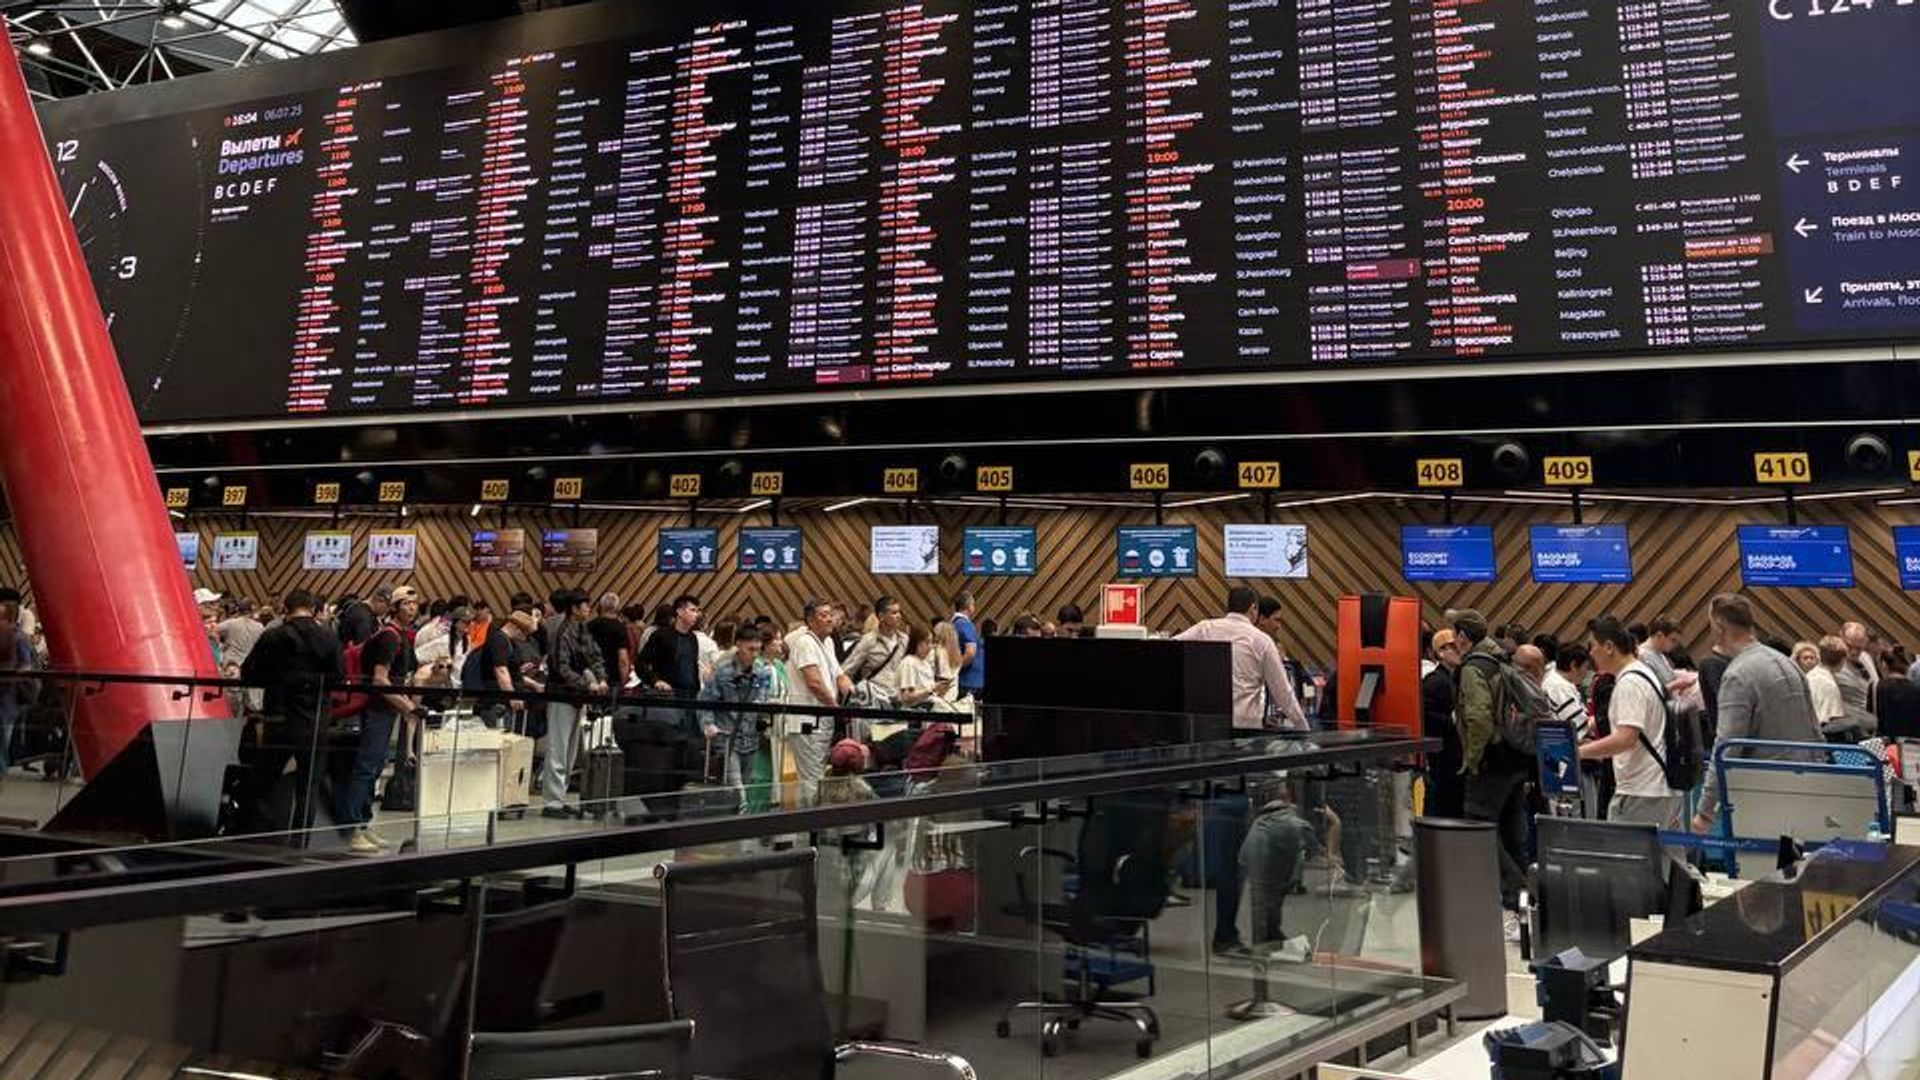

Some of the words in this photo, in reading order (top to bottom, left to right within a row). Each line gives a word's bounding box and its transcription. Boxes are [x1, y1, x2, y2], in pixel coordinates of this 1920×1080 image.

[56, 140, 80, 162] 12
[221, 135, 281, 157] Вылеты
[219, 149, 304, 175] Departures
[1147, 152, 1178, 163] 19:00
[1823, 148, 1900, 163] Терминалы
[1825, 163, 1887, 177] Terminals
[214, 185, 223, 200] B
[226, 184, 236, 198] C
[240, 181, 251, 196] D
[253, 180, 263, 194] E
[267, 177, 277, 192] F
[1828, 181, 1838, 193] B
[1848, 179, 1862, 191] D
[1870, 178, 1880, 190] E
[1891, 176, 1901, 188] F
[1447, 198, 1484, 211] 20:00
[1832, 215, 1875, 227] Поезд
[1877, 215, 1885, 223] в
[1833, 230, 1866, 242] Train
[1870, 229, 1883, 239] to
[118, 256, 137, 279] 3
[1556, 268, 1582, 279] Sochi
[1241, 466, 1277, 483] 407
[1420, 463, 1460, 481] 408
[1548, 462, 1589, 479] 409
[1759, 458, 1806, 477] 410
[753, 475, 780, 492] 403
[886, 472, 915, 488] 404
[979, 470, 1010, 486] 405
[1133, 468, 1166, 484] 406
[316, 486, 337, 500] 398
[380, 484, 402, 499] 399
[483, 482, 506, 497] 400
[555, 481, 579, 496] 401
[672, 478, 697, 493] 402
[224, 489, 244, 503] 397
